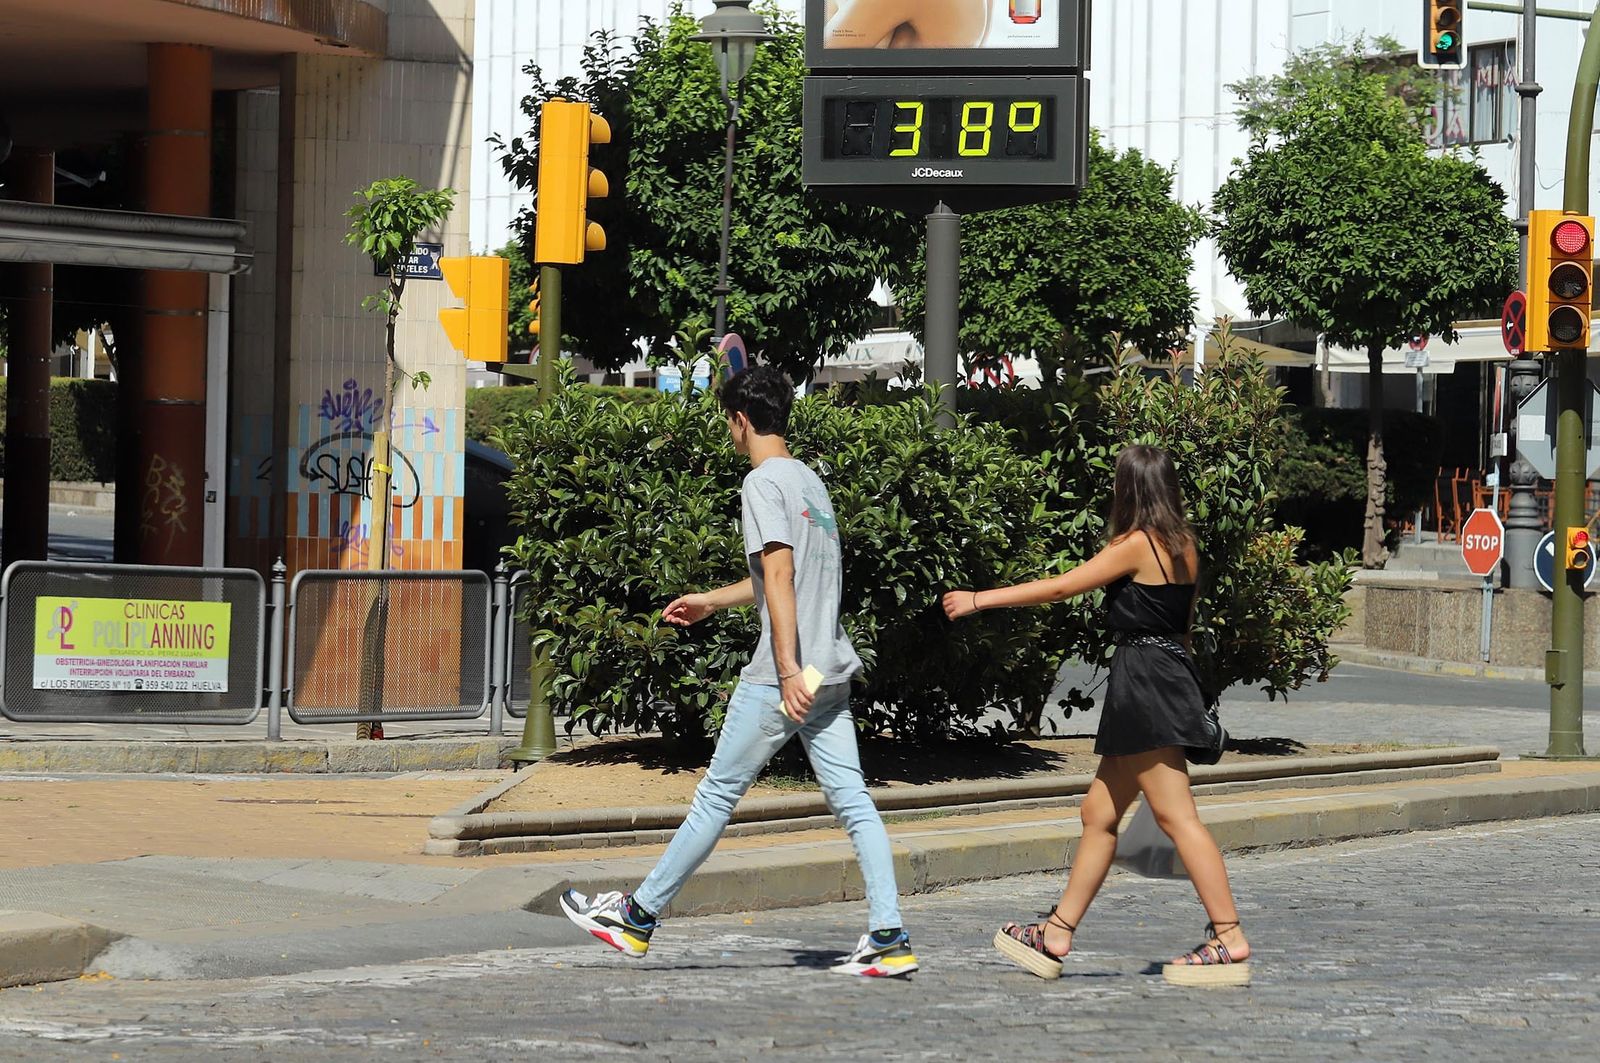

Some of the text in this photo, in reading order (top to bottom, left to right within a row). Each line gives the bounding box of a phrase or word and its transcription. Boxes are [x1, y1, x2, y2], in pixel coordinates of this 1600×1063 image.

[911, 167, 964, 178] JCDecaux
[1465, 534, 1499, 551] STOP
[123, 602, 185, 620] CLINICAS
[92, 620, 215, 650] POLIPLANNING
[181, 660, 208, 669] FAMILIAR
[115, 669, 149, 677] VOLUNTARIA
[151, 669, 162, 677] DEL
[164, 670, 196, 678] EMBARAZO
[50, 679, 68, 688] LOS
[70, 680, 111, 689] ROMEROS
[145, 680, 159, 690] 959
[160, 681, 174, 690] 540
[175, 681, 189, 690] 222
[191, 681, 222, 690] HUELVA
